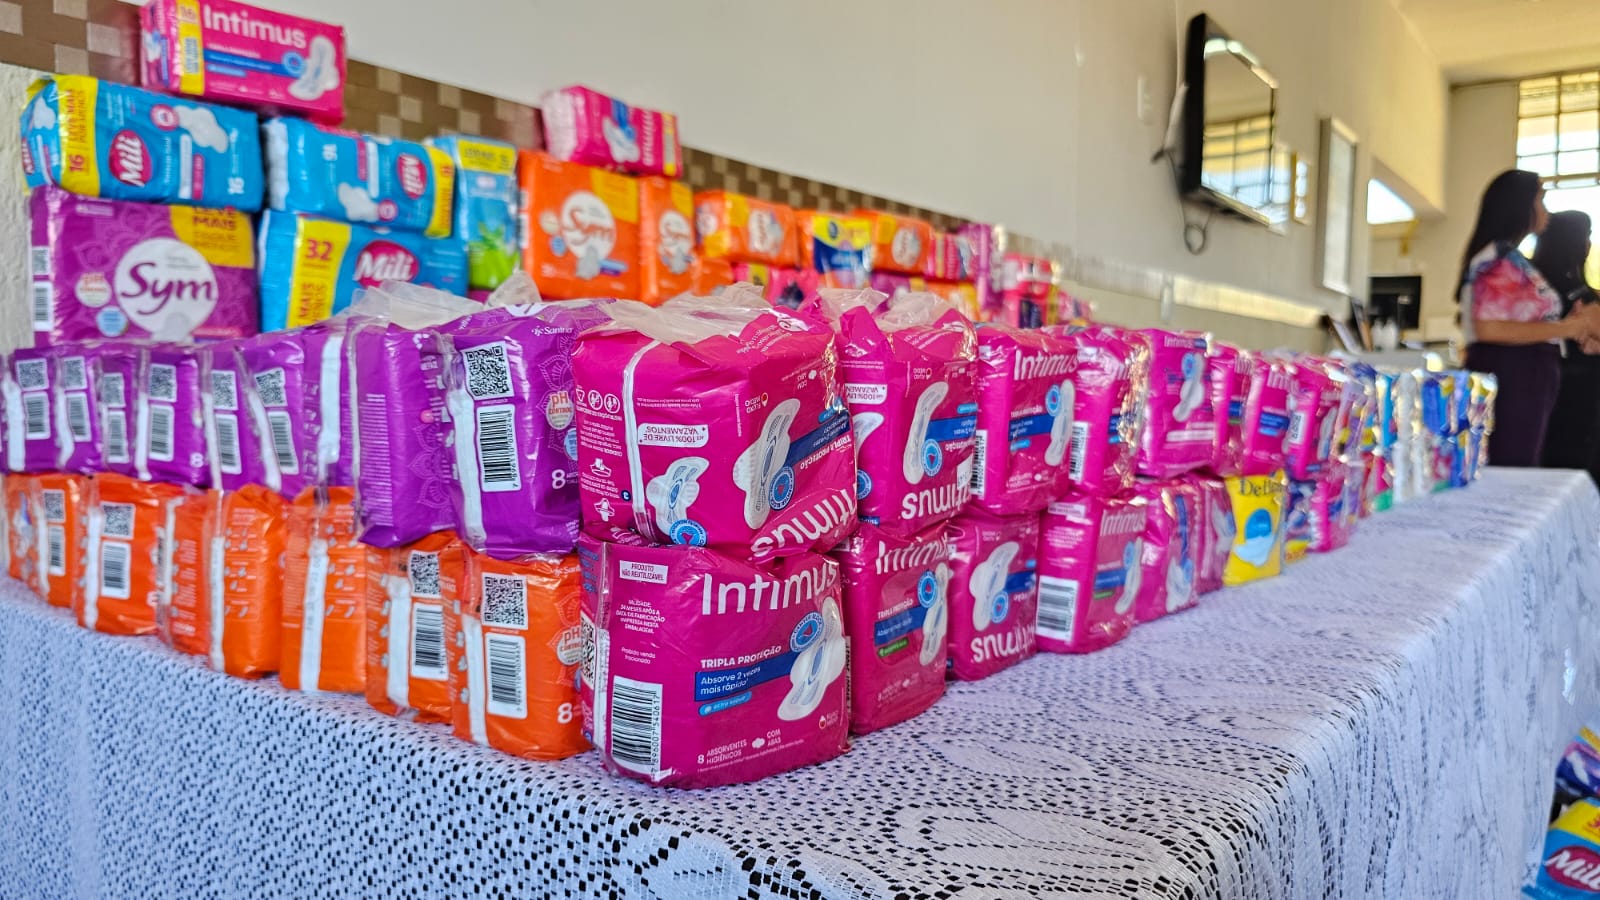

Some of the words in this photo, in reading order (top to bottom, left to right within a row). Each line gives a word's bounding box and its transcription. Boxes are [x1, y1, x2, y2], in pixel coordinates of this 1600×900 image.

[203, 4, 307, 49] Intimus
[116, 135, 146, 187] Mili
[305, 238, 334, 261] 32
[352, 251, 414, 282] Mili
[120, 262, 212, 315] Sym
[1014, 350, 1077, 380] Intimus
[551, 393, 569, 408] pH
[675, 435, 695, 443] 100%
[190, 453, 204, 467] 8
[551, 469, 566, 490] 8
[1100, 509, 1146, 536] Intimus
[702, 563, 840, 615] Intimus
[701, 657, 735, 669] TRIPLA
[737, 645, 782, 665] PROTEÇÃO
[700, 685, 721, 695] mais
[701, 673, 736, 685] Absorve
[737, 671, 742, 680] 2
[556, 703, 573, 724] 8
[651, 694, 660, 726] 540617
[766, 729, 781, 739] COM
[697, 754, 704, 764] 8
[706, 738, 748, 757] ABSORVENTES
